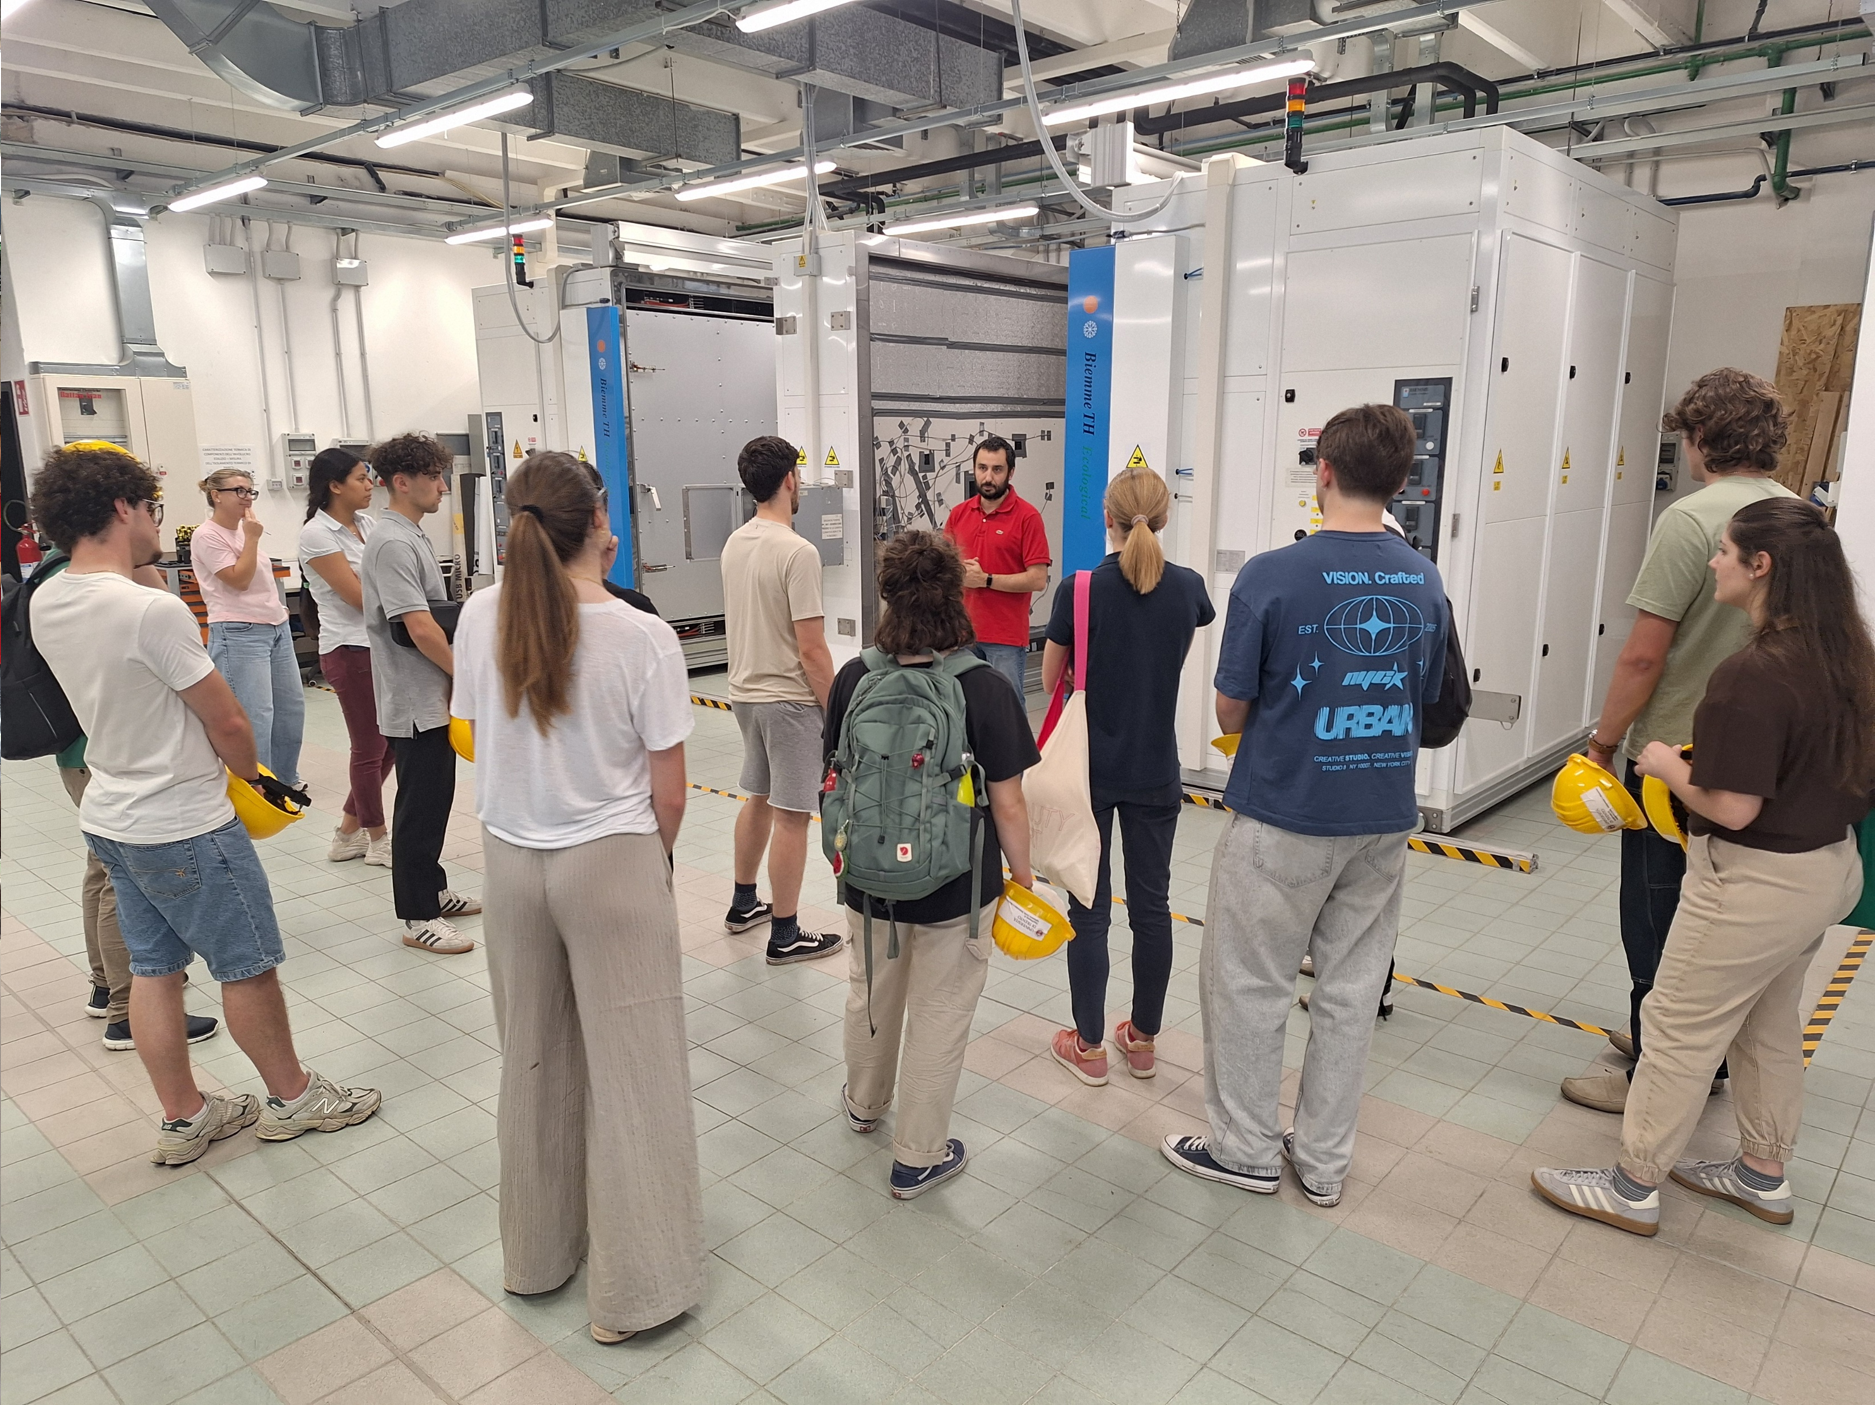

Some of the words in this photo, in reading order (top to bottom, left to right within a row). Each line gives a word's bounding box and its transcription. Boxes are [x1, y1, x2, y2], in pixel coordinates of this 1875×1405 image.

[1084, 352, 1096, 410] Biemme
[1083, 412, 1096, 436] TH
[1078, 446, 1092, 520] Ecological
[1322, 572, 1372, 584] VISION.
[1375, 572, 1424, 584] Crafted
[1298, 624, 1319, 634] EST.
[1314, 702, 1414, 740] URBAN
